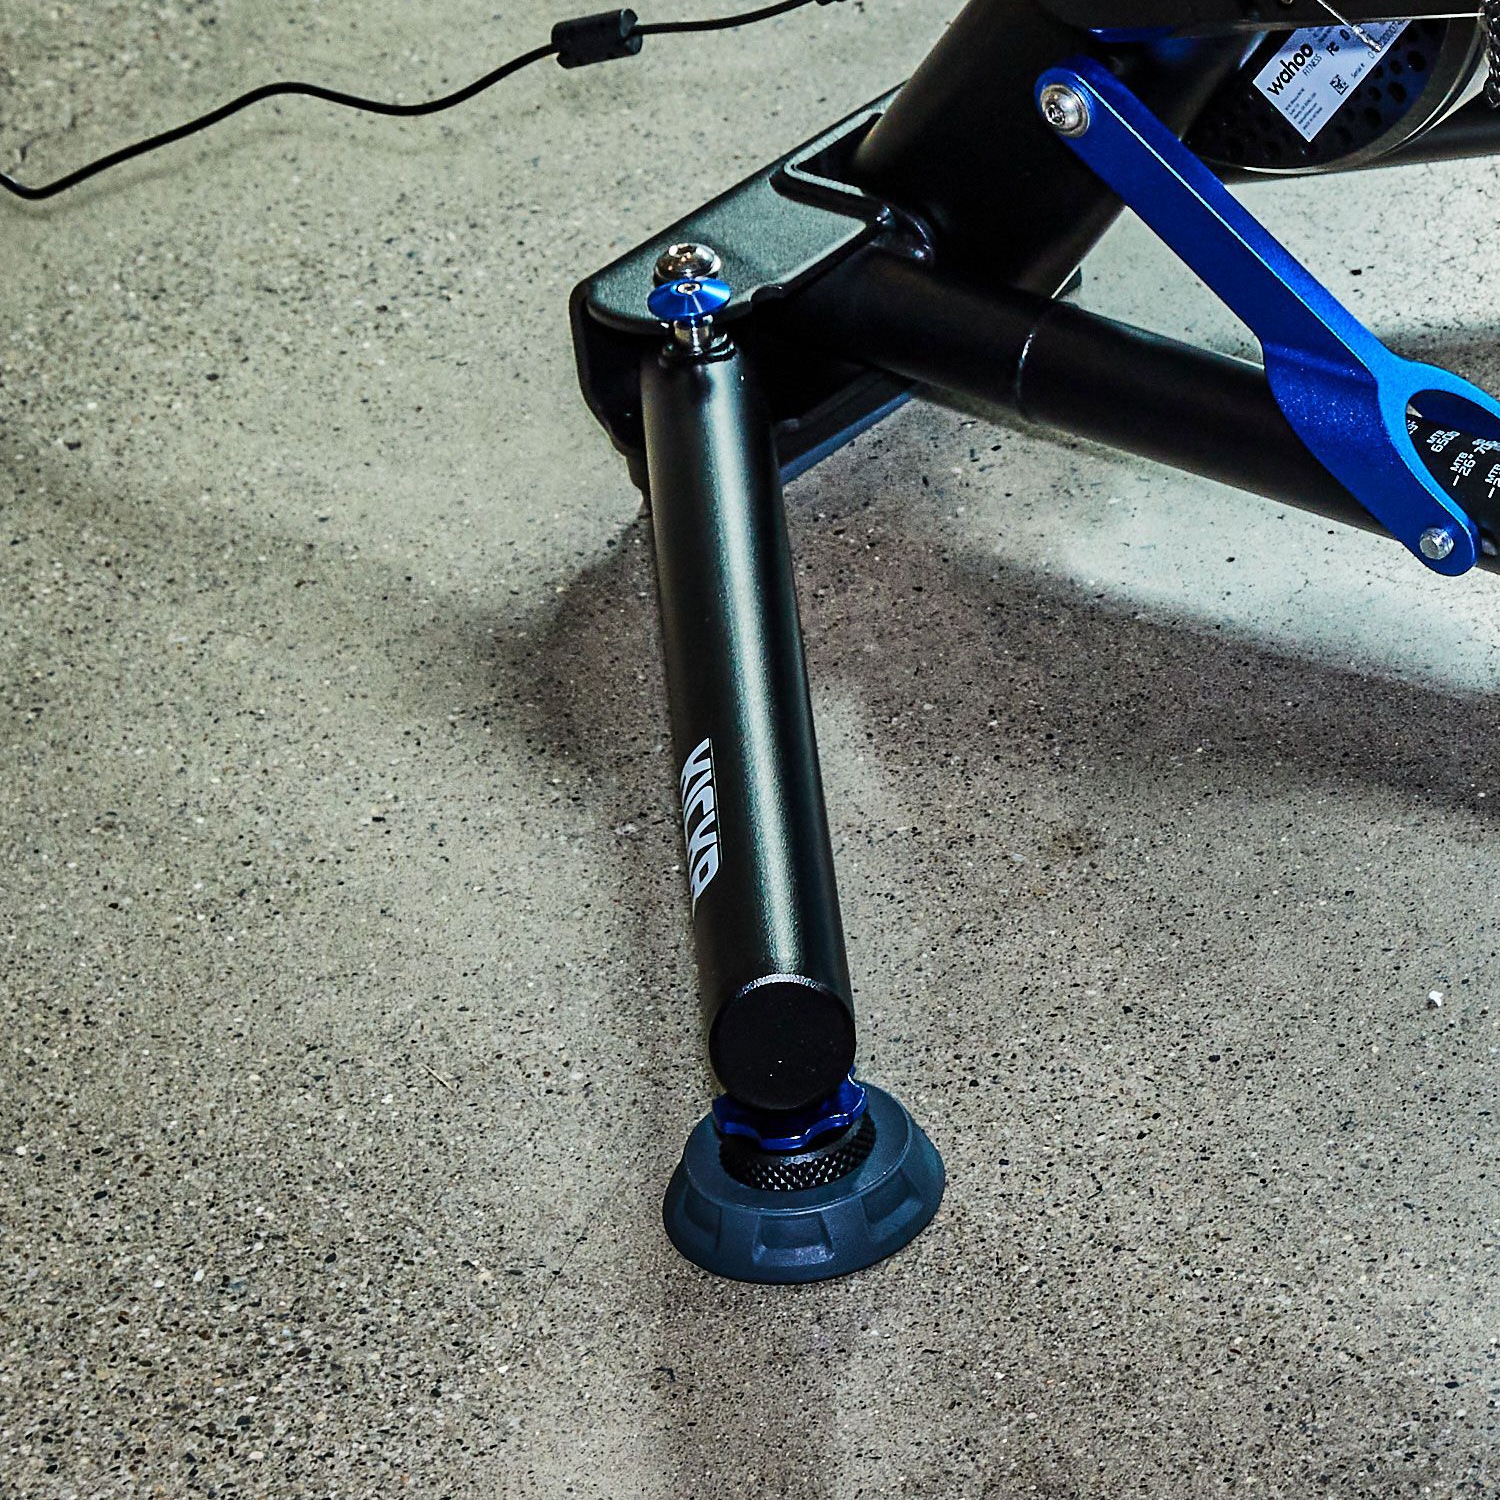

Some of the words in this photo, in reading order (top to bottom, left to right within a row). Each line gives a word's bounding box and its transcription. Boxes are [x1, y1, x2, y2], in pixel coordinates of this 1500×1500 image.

[1267, 43, 1314, 95] wahoo
[1302, 53, 1323, 77] FITNESS
[1427, 430, 1445, 444] MTB
[1450, 452, 1468, 471] MTB
[1459, 454, 1476, 477] 26"
[680, 737, 720, 912] KICKR
